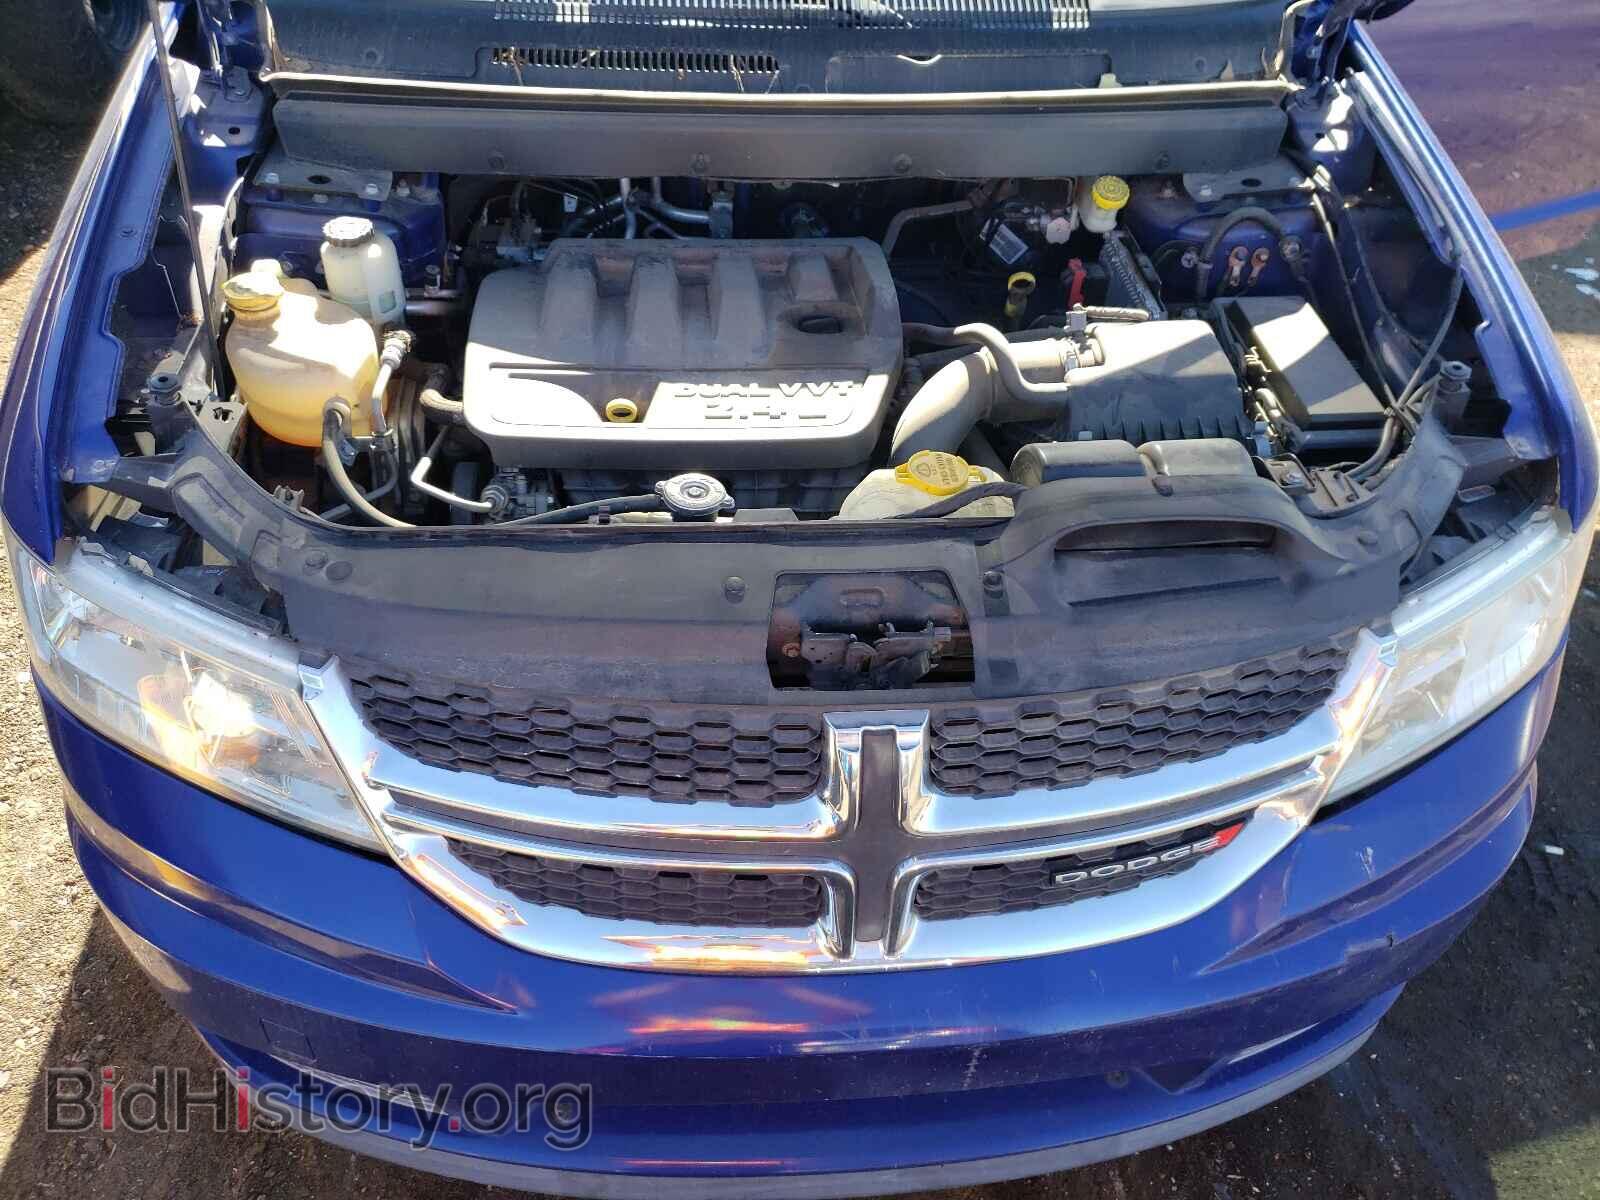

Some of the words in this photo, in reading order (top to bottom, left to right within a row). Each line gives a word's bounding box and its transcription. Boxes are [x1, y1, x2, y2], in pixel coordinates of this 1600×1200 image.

[673, 382, 770, 399] DUAL
[777, 381, 854, 398] VVT
[1055, 836, 1220, 885] DODGE
